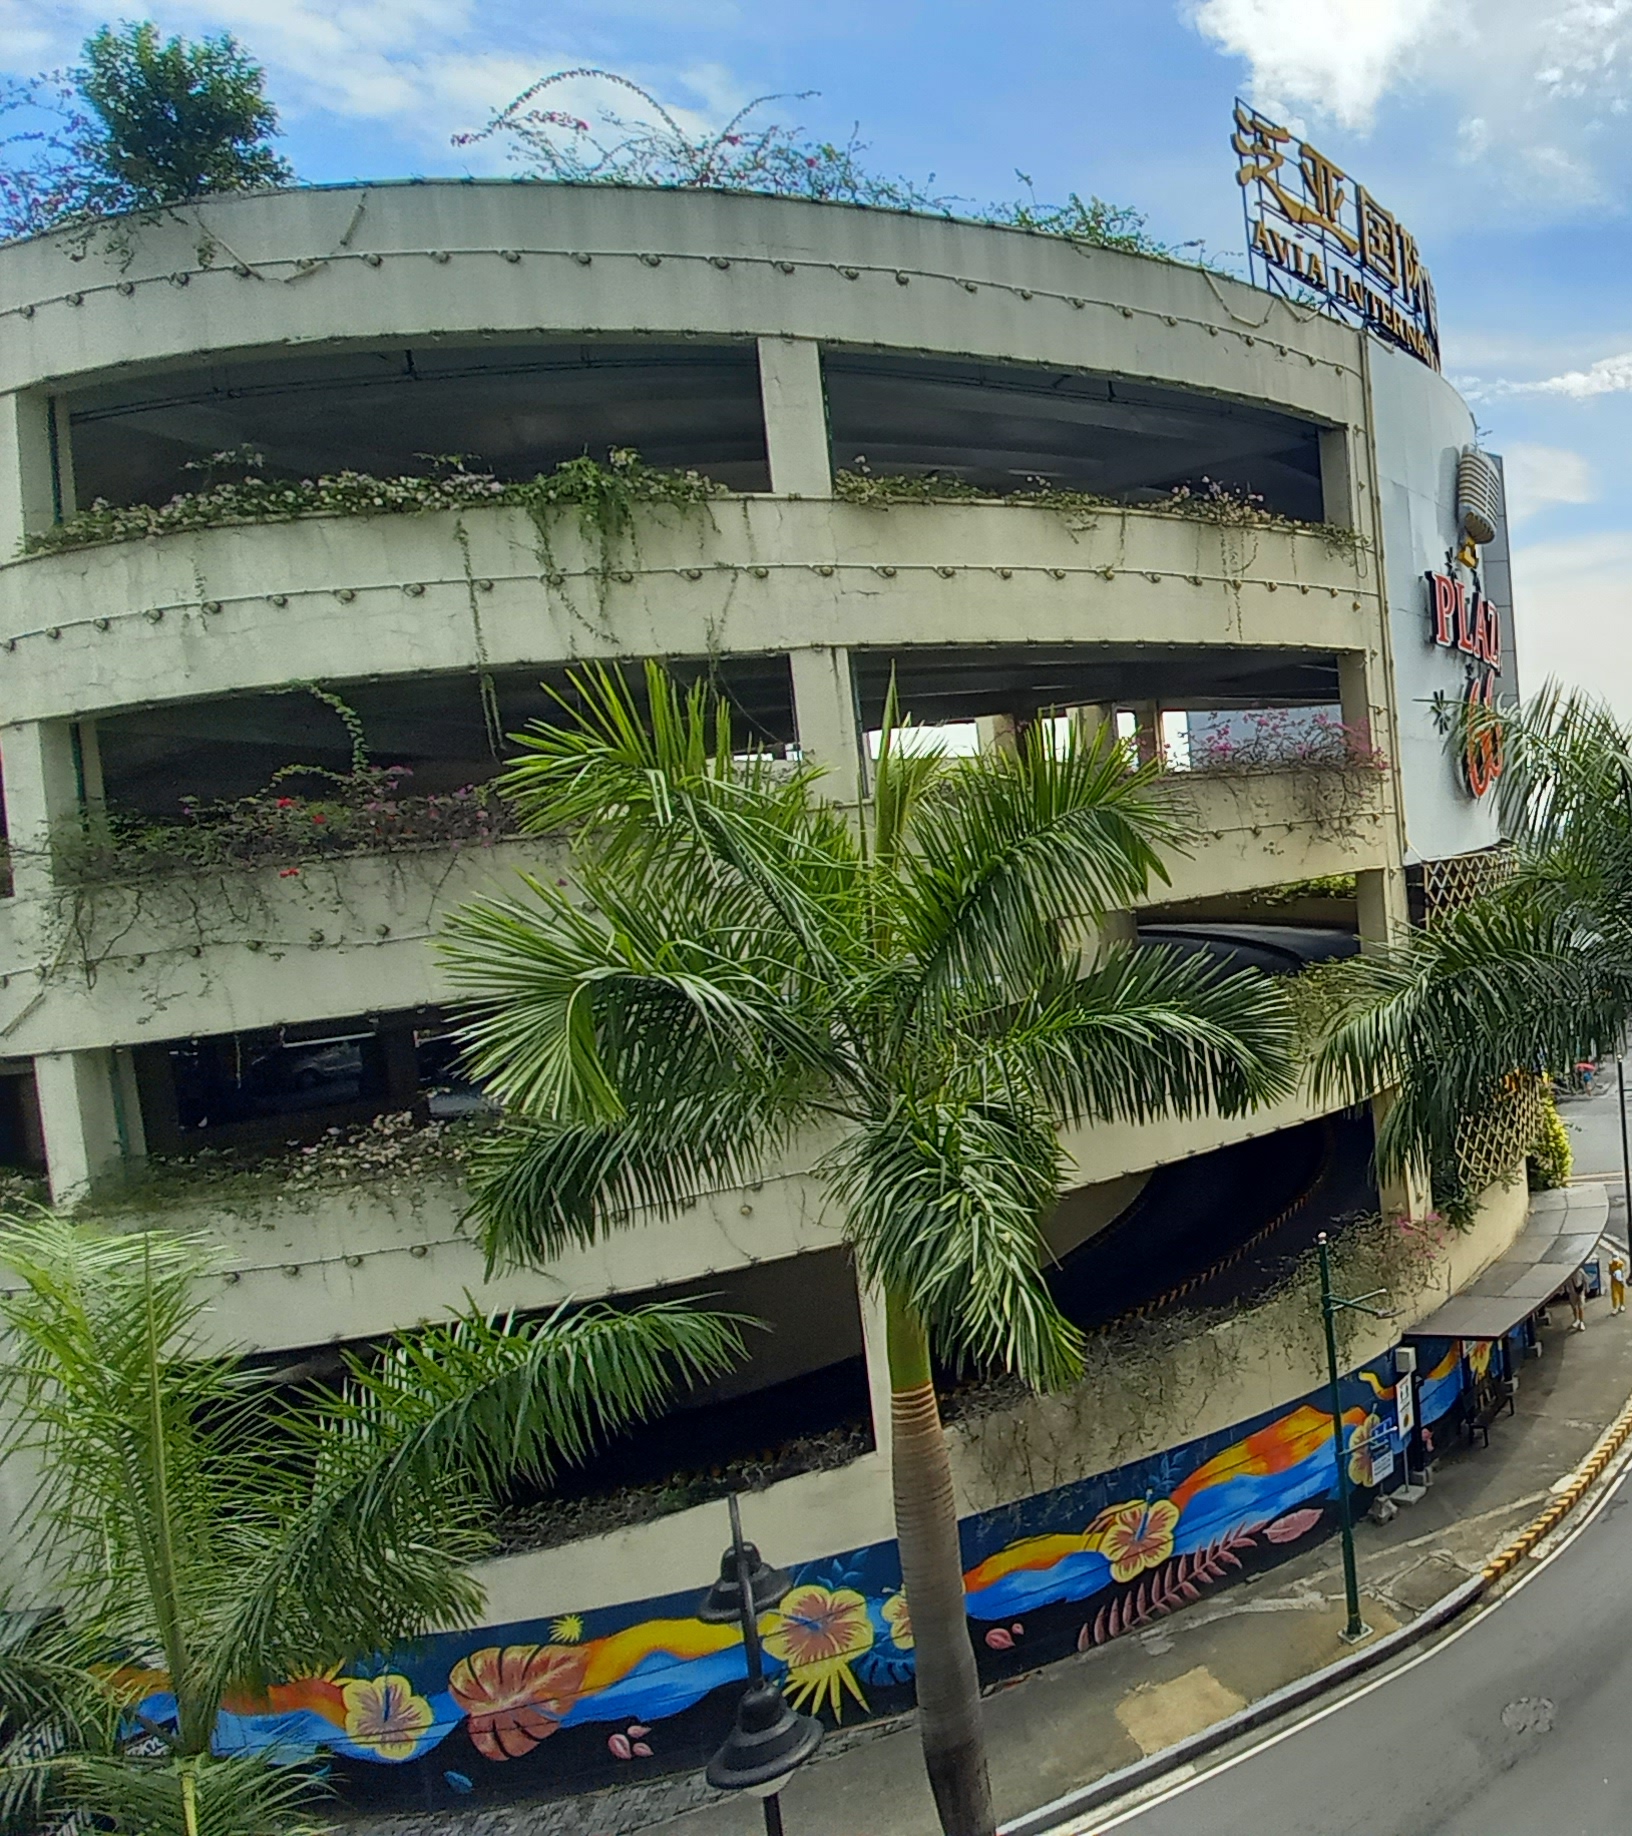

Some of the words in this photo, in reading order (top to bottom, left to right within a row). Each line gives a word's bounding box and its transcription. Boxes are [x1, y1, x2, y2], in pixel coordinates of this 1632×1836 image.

[1231, 107, 1438, 335] 泛亚国际
[1252, 220, 1327, 289] AVIA
[1432, 571, 1502, 674] PLAZ
